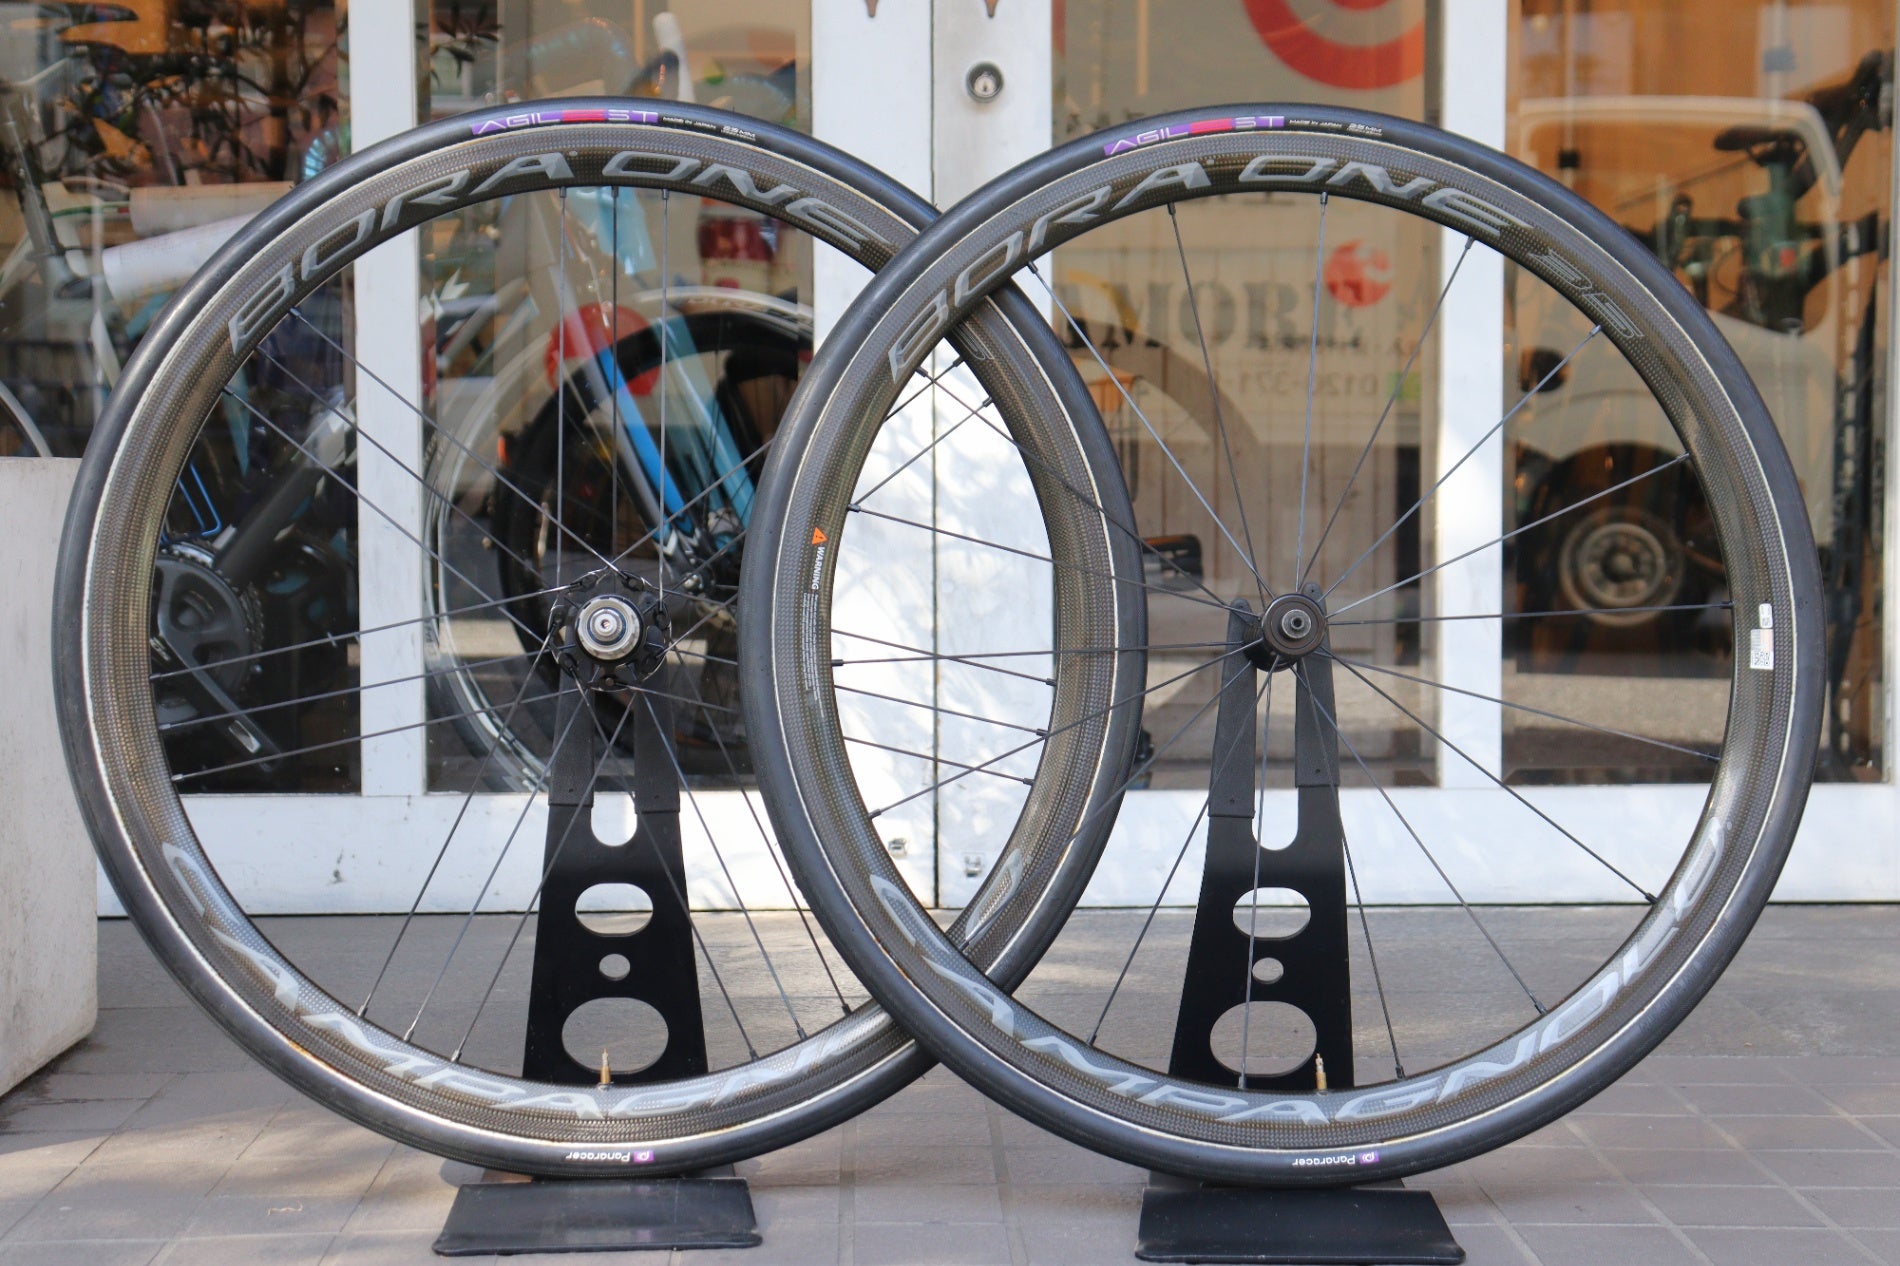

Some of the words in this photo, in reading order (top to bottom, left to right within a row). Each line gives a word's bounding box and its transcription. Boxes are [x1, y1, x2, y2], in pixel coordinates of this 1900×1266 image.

[228, 151, 573, 355] BORA
[602, 151, 892, 252] ONE
[888, 161, 1211, 384] BORA
[1238, 155, 1534, 238] ONE
[1527, 248, 1645, 338] 35
[811, 546, 826, 590] WARNING
[869, 816, 1727, 1125] CAMPAGNOLO
[565, 1151, 631, 1162] Panaracer
[1292, 1154, 1356, 1167] Panaracer
